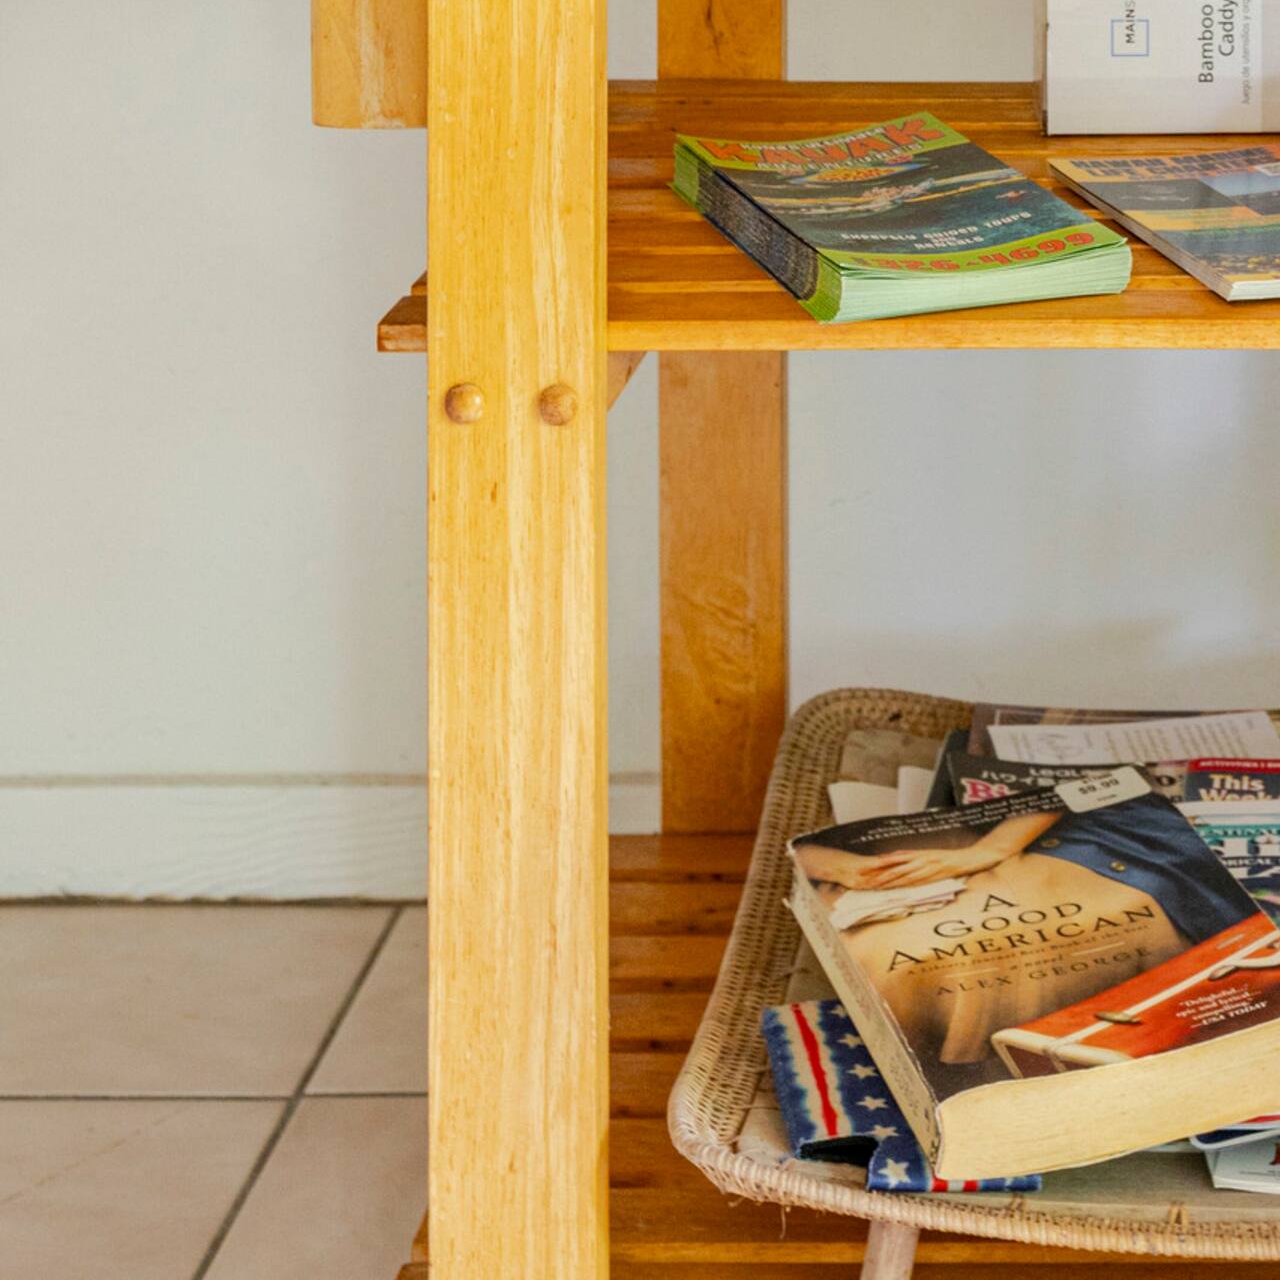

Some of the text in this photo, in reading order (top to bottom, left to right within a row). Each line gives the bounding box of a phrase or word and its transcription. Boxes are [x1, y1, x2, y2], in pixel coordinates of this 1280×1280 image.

[1198, 4, 1214, 83] Bamboo
[1209, 774, 1264, 791] This
[933, 902, 1082, 938] GOOD
[982, 894, 1017, 912] A
[887, 905, 1156, 973] AMERICAN
[936, 947, 1151, 996] ALEX GEORGE
